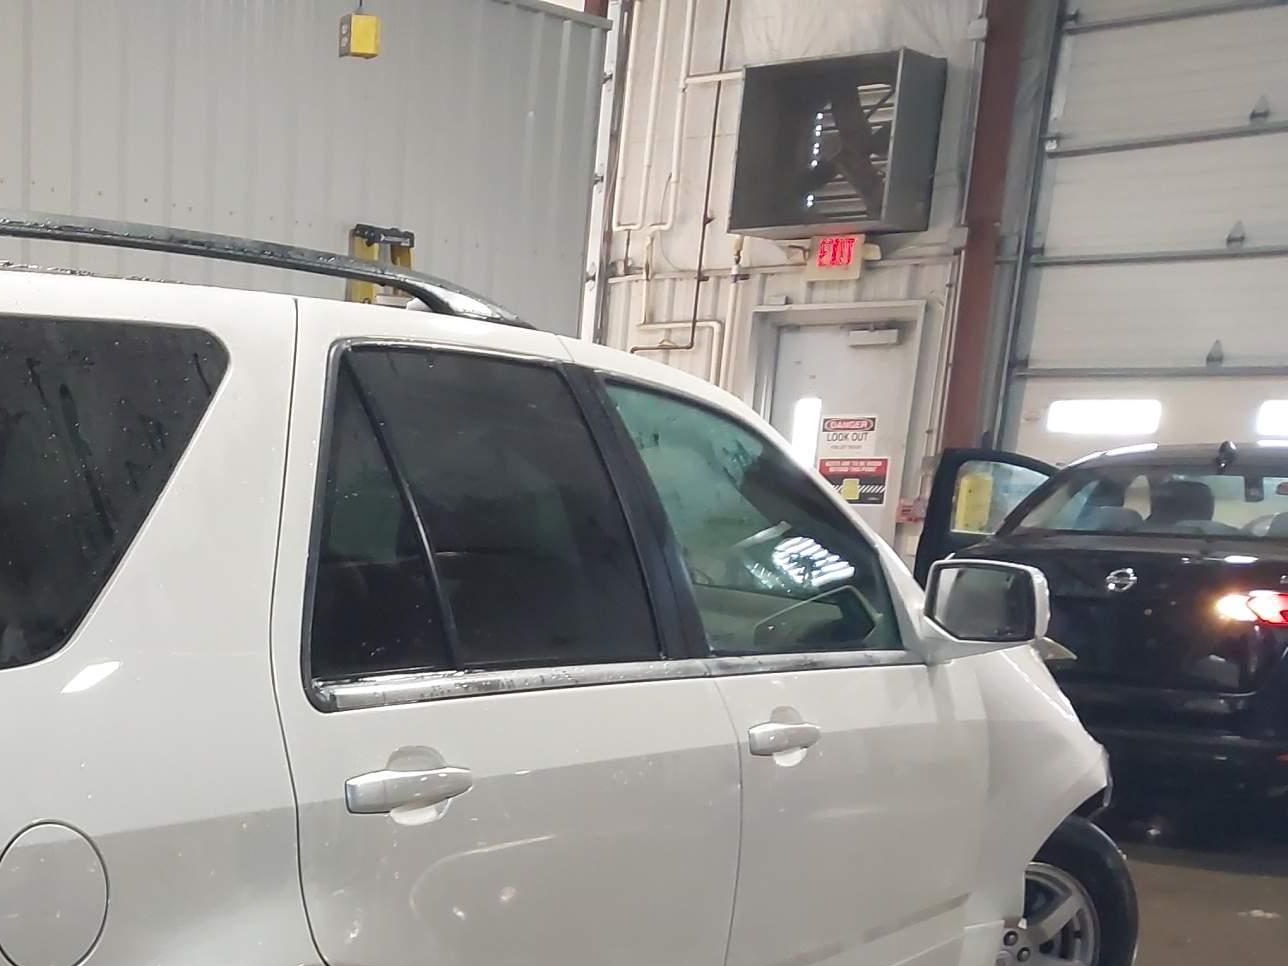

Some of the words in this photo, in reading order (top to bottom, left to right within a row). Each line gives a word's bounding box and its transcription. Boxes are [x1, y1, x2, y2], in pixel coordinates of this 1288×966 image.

[816, 237, 857, 267] EXIT
[830, 420, 868, 429] DANGER
[826, 432, 850, 442] LOOK
[851, 432, 869, 441] OUT
